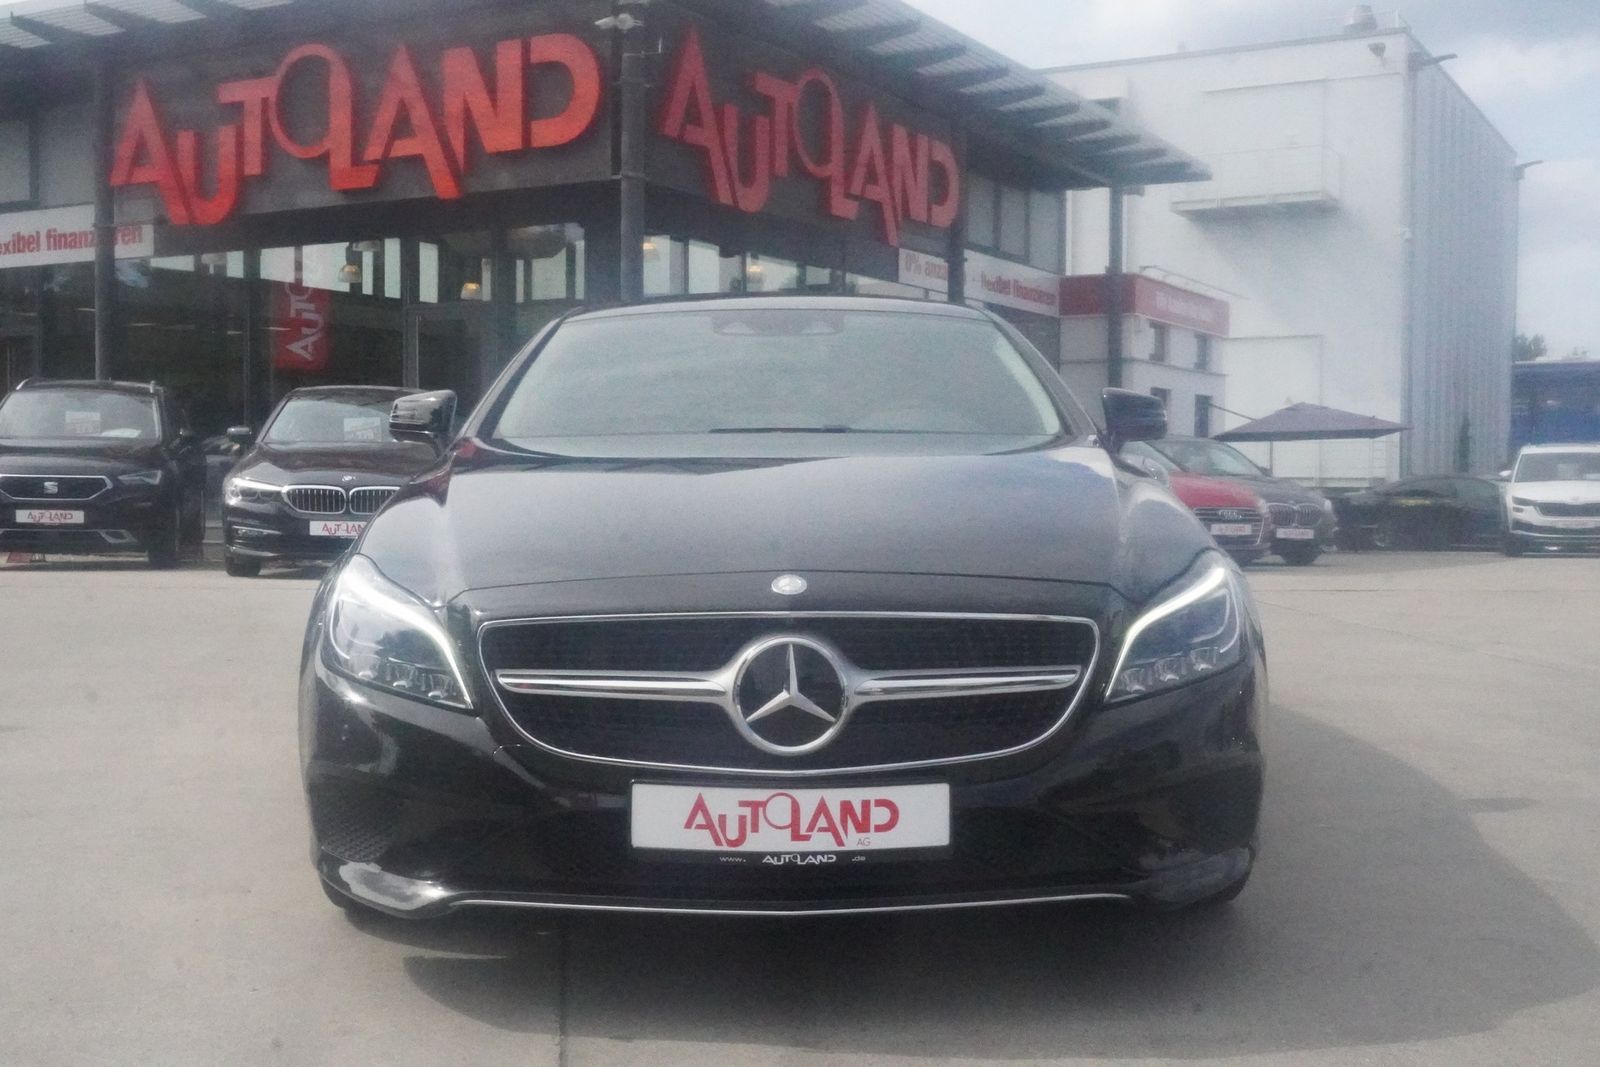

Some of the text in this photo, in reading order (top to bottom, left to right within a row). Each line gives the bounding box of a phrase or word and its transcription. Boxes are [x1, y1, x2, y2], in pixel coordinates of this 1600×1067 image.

[109, 32, 600, 225] AUTOLAND
[661, 26, 960, 247] AUTOLAND
[684, 792, 900, 848] AUTOLAND
[856, 837, 872, 847] AG
[762, 853, 837, 866] AUTOLAND
